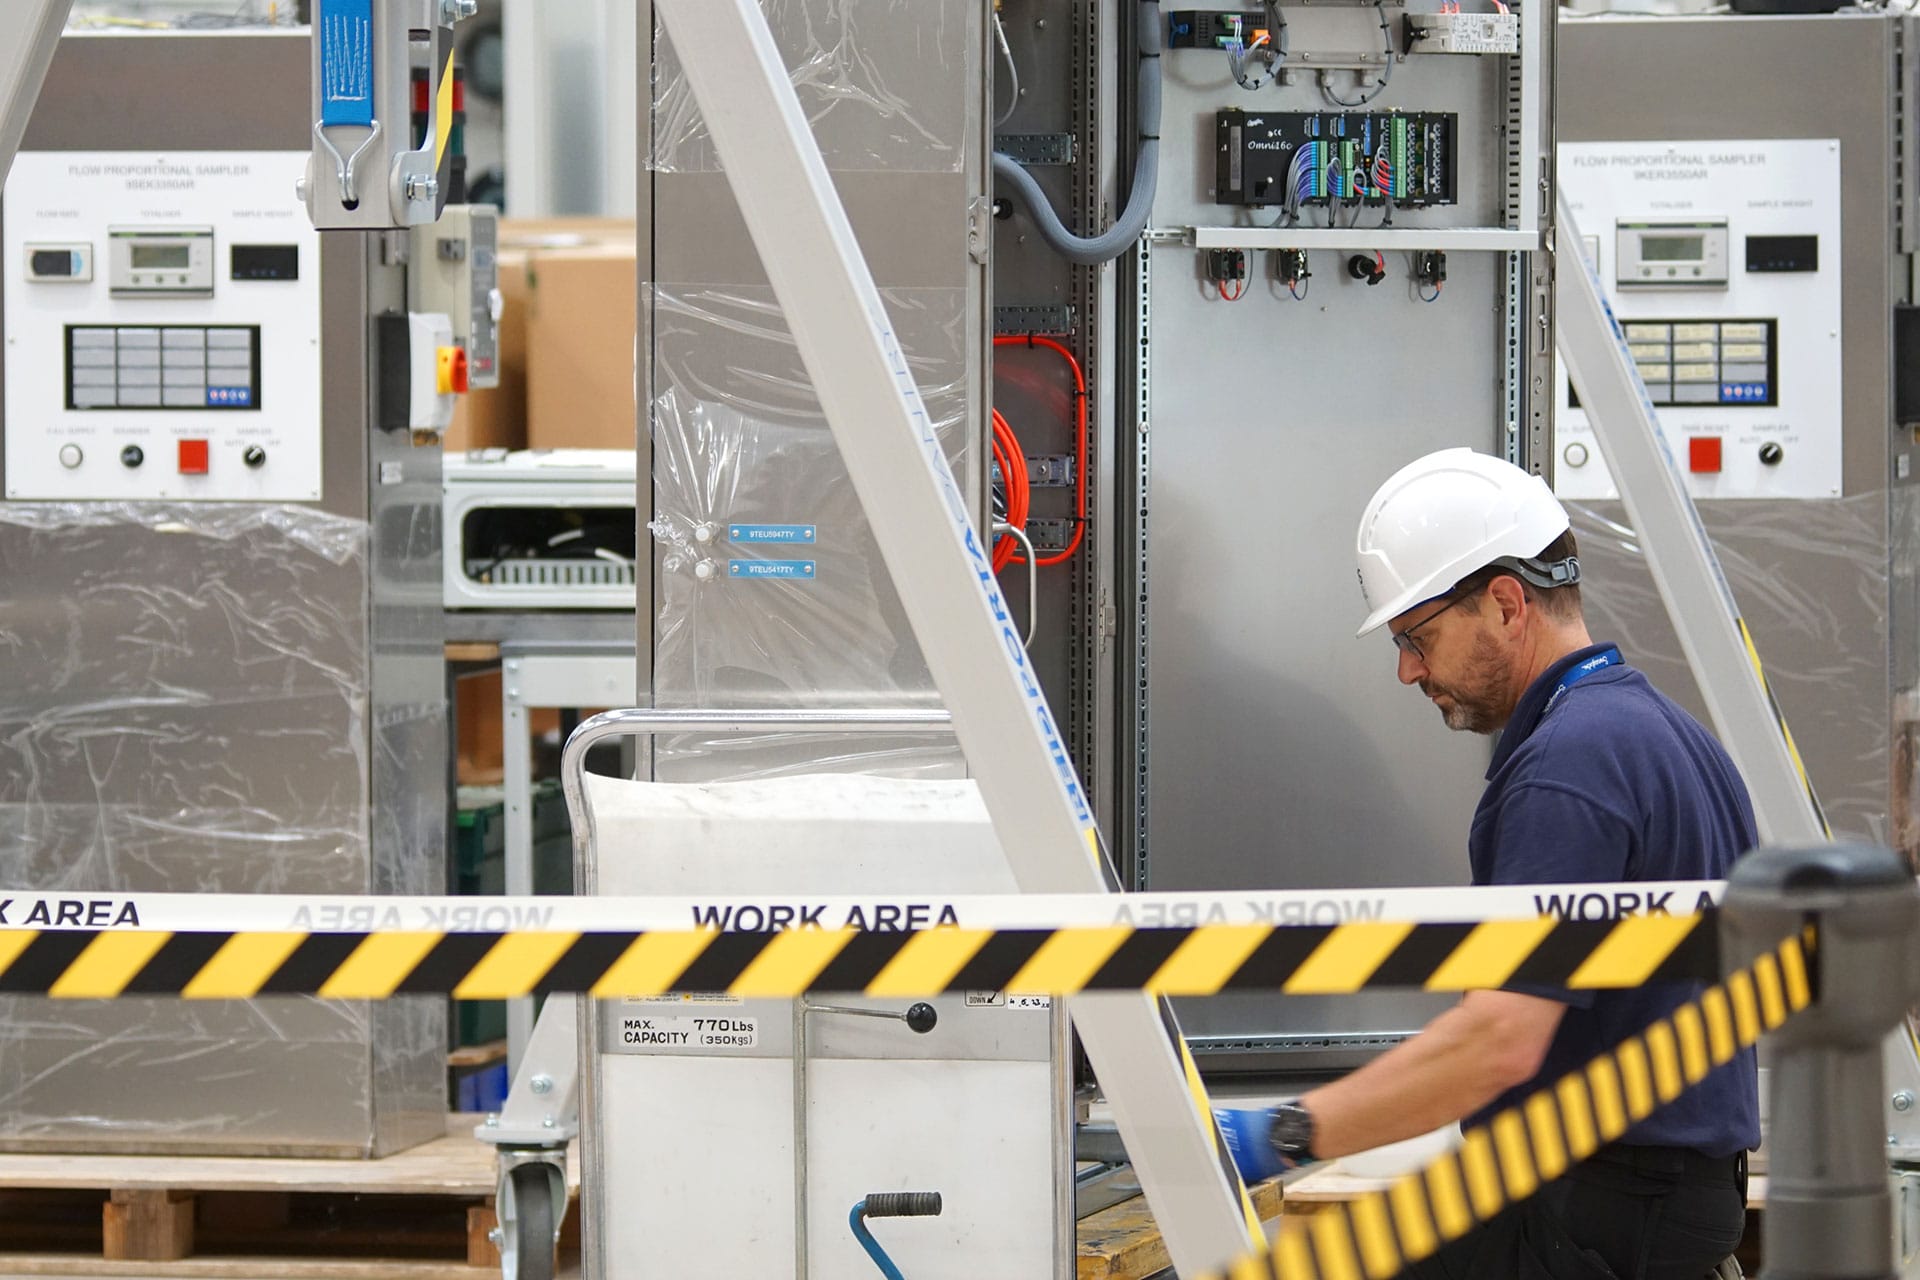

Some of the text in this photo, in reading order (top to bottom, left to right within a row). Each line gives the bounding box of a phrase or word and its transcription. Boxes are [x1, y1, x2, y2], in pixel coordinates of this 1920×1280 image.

[1573, 153, 1766, 167] FLOW PROPORTIONAL SAMPLER
[68, 165, 249, 176] FLOW PROPORTIONAL SAMPLER
[1533, 892, 1675, 920] WORK
[22, 901, 141, 927] AREA
[692, 904, 961, 931] WORK AREA
[624, 1020, 655, 1030] MAX.
[624, 1032, 689, 1044] CAPACITY
